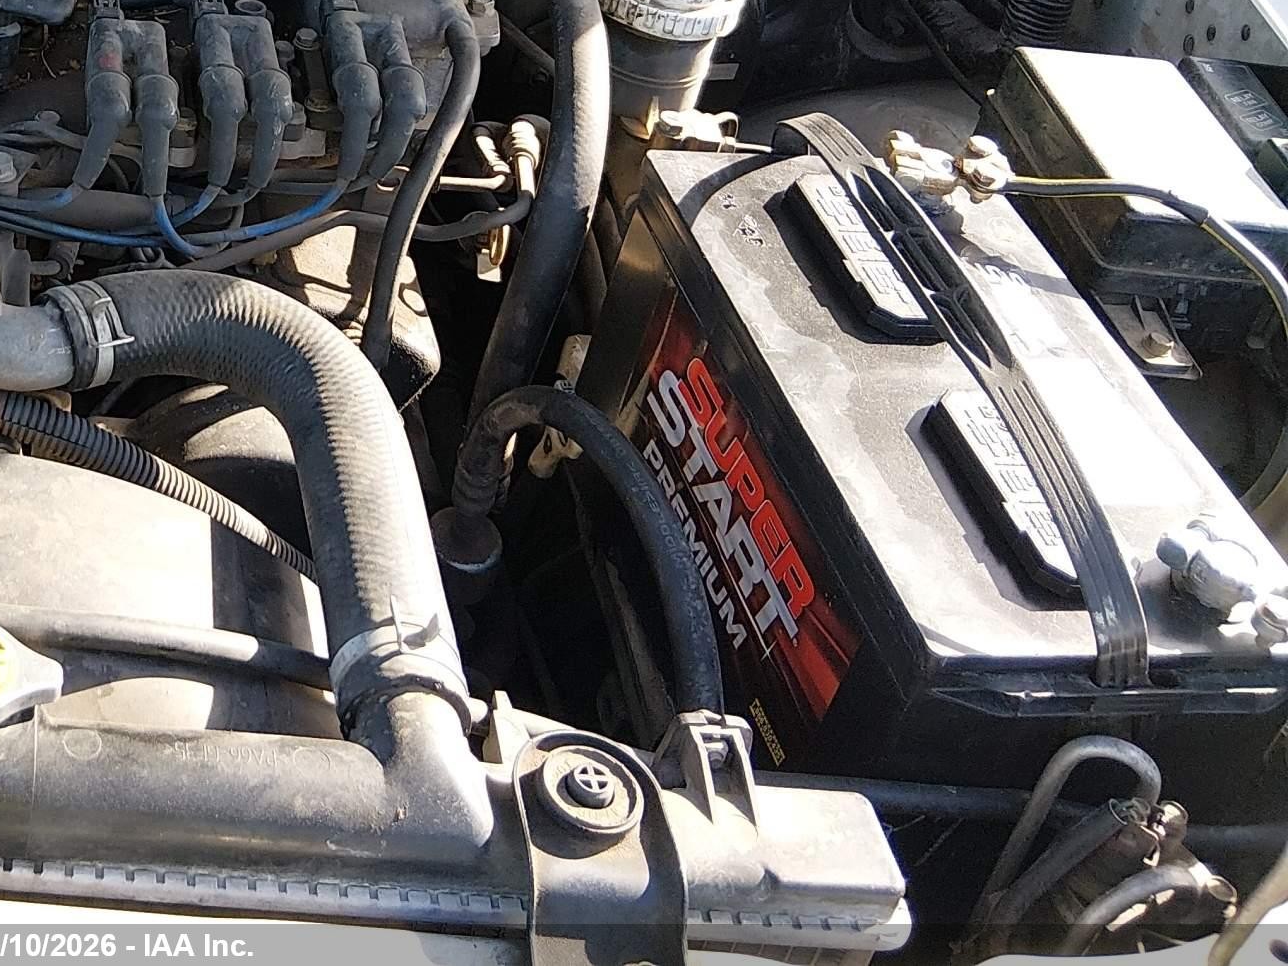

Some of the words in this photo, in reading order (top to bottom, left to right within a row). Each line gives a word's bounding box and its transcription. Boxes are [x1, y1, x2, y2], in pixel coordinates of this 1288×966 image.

[642, 437, 748, 651] PREMIUM
[646, 369, 800, 642] START
[678, 356, 816, 619] SUPER
